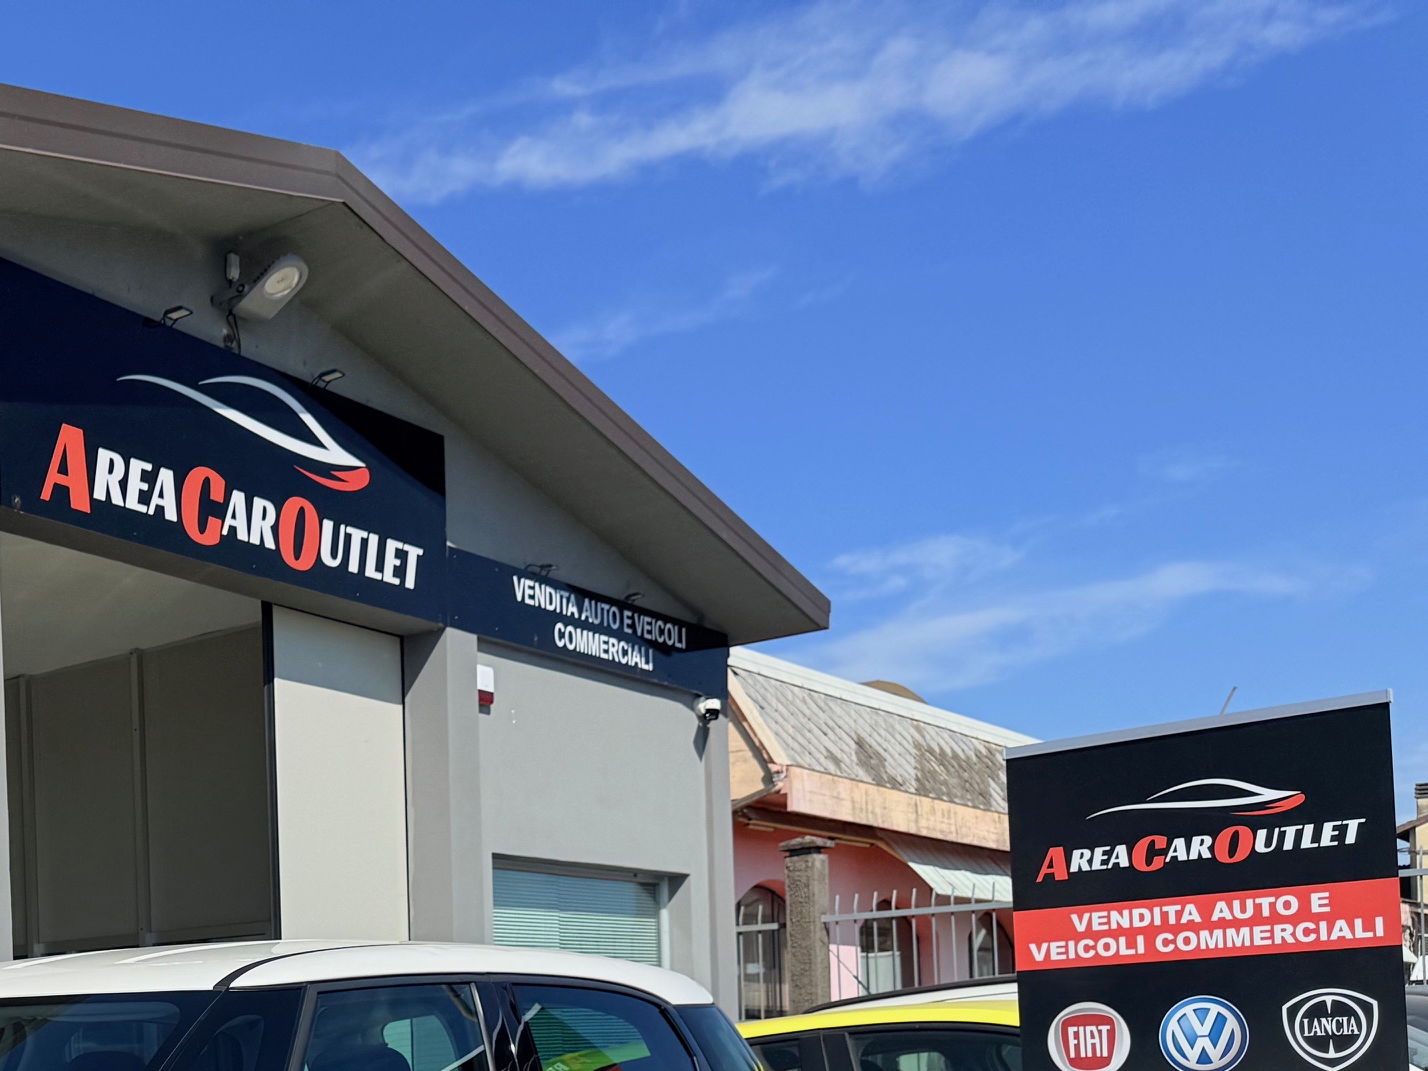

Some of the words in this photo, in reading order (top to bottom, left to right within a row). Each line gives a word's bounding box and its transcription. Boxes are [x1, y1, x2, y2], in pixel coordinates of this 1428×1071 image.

[513, 575, 578, 619] VENDITA
[581, 598, 620, 630] AUTO
[623, 610, 633, 634] E
[634, 613, 687, 650] VEICOLI
[554, 622, 654, 671] COMMERCIALI
[1070, 904, 1201, 933] VENDITA
[1210, 894, 1299, 921] AUTO
[1311, 892, 1330, 913] E
[1028, 934, 1144, 963] VEICOLI
[1155, 916, 1385, 954] COMMERCIALI
[1067, 1024, 1111, 1059] FIAT
[1303, 1016, 1360, 1037] LANCIA
